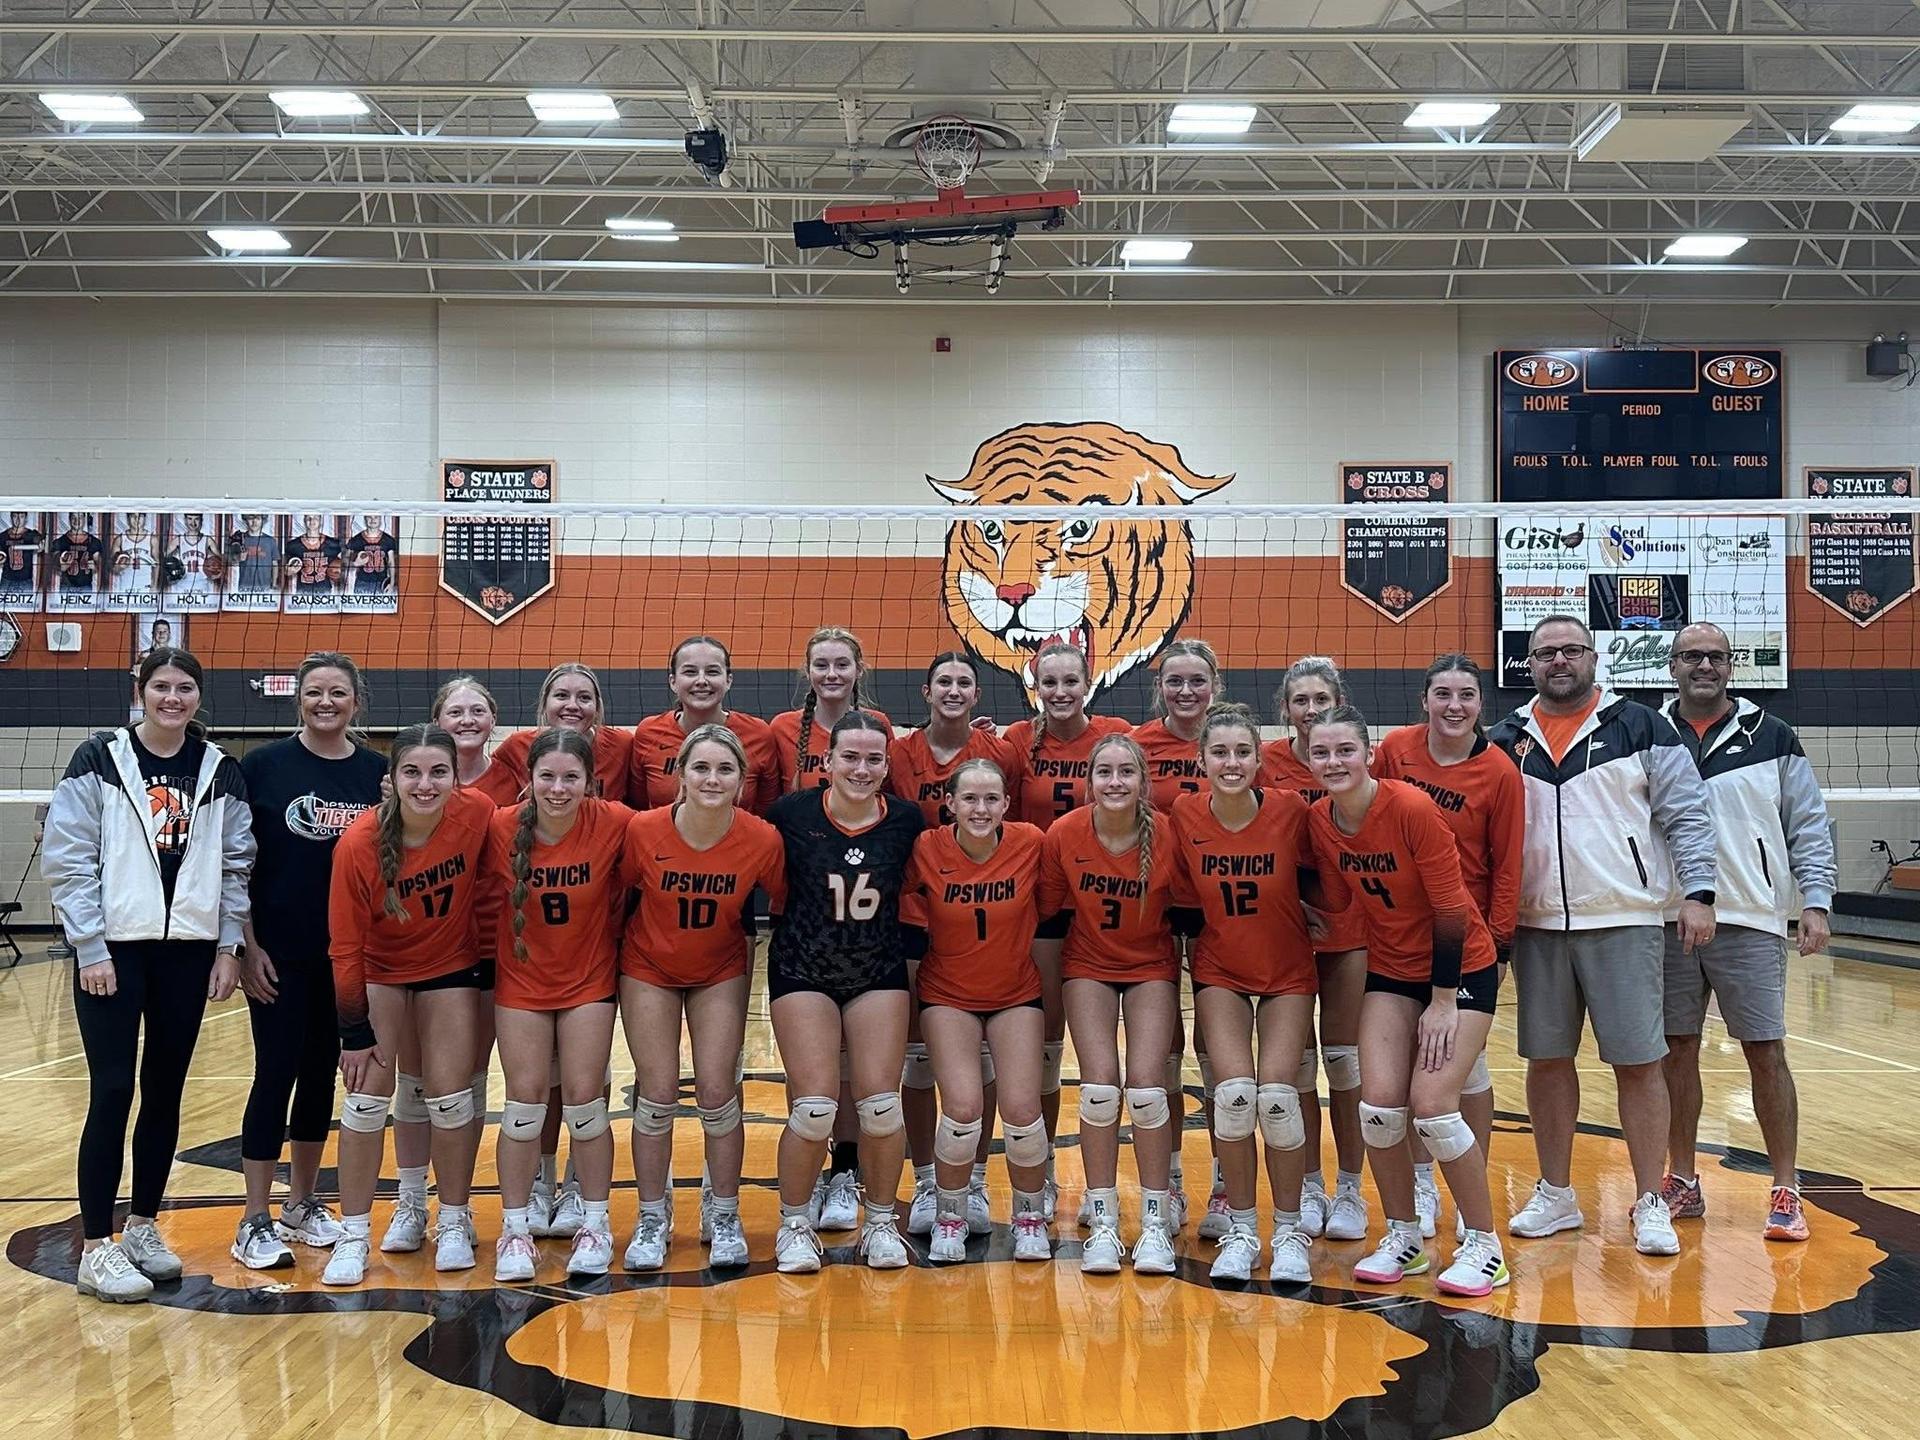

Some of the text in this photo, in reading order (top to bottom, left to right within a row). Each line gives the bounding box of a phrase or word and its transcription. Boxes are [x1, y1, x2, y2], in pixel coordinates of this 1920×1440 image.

[1523, 395, 1569, 411] HOME
[1622, 404, 1661, 416] PERIOD
[1712, 395, 1763, 411] GUEST
[1513, 456, 1548, 467] FOULS
[1562, 456, 1592, 467] T.O.L.
[1603, 456, 1680, 467] PLAYER FOUL
[1691, 456, 1721, 467] T.O.L.
[1733, 456, 1768, 467] FOULS
[470, 472, 525, 487] STATE
[1367, 471, 1425, 484] STATE B
[1363, 485, 1430, 499] CROSS
[1832, 478, 1886, 493] STATE
[446, 489, 550, 499] PLACE WINNERS
[1364, 517, 1428, 526] COMBINED
[1809, 522, 1912, 536] BASKETBALL
[1347, 527, 1446, 537] CHAMPIONSHIPS
[1504, 526, 1562, 550] Gisi
[1610, 525, 1644, 547] Seed
[1826, 538, 1842, 546] Class
[1622, 540, 1686, 561] Solutions
[1826, 548, 1842, 556] Class
[1827, 558, 1843, 566] Class
[1827, 568, 1843, 576] Class
[1622, 579, 1659, 597] 1922
[61, 594, 91, 604] HEINZ
[109, 594, 158, 605] HETTICH
[177, 594, 207, 605] HOLT
[228, 592, 275, 603] KNITTEL
[292, 595, 335, 605] RAUSCH
[341, 595, 397, 605] SEVERSON
[1622, 597, 1649, 607] PUB
[1622, 606, 1659, 616] GRUB
[1033, 759, 1088, 779] IPSWIC
[1158, 759, 1208, 778] IPSWI
[1052, 782, 1073, 817] 5
[314, 807, 365, 828] TIGE
[312, 828, 346, 836] VOLLE
[1201, 853, 1275, 877] IPSWICH
[1339, 851, 1398, 874] IPSWICH
[399, 852, 466, 901] IPSWICH
[523, 861, 591, 887] PSWICH
[661, 870, 737, 895] IPSWICH
[1079, 872, 1149, 900] IPSWICH
[828, 872, 881, 922] 16
[944, 878, 1016, 904] IPSWICH
[1361, 876, 1396, 910] 4
[420, 884, 455, 919] 17
[1220, 881, 1259, 917] 12
[540, 892, 570, 926] 8
[677, 897, 719, 930] 10
[1100, 898, 1122, 930] 3
[974, 907, 987, 941] 1
